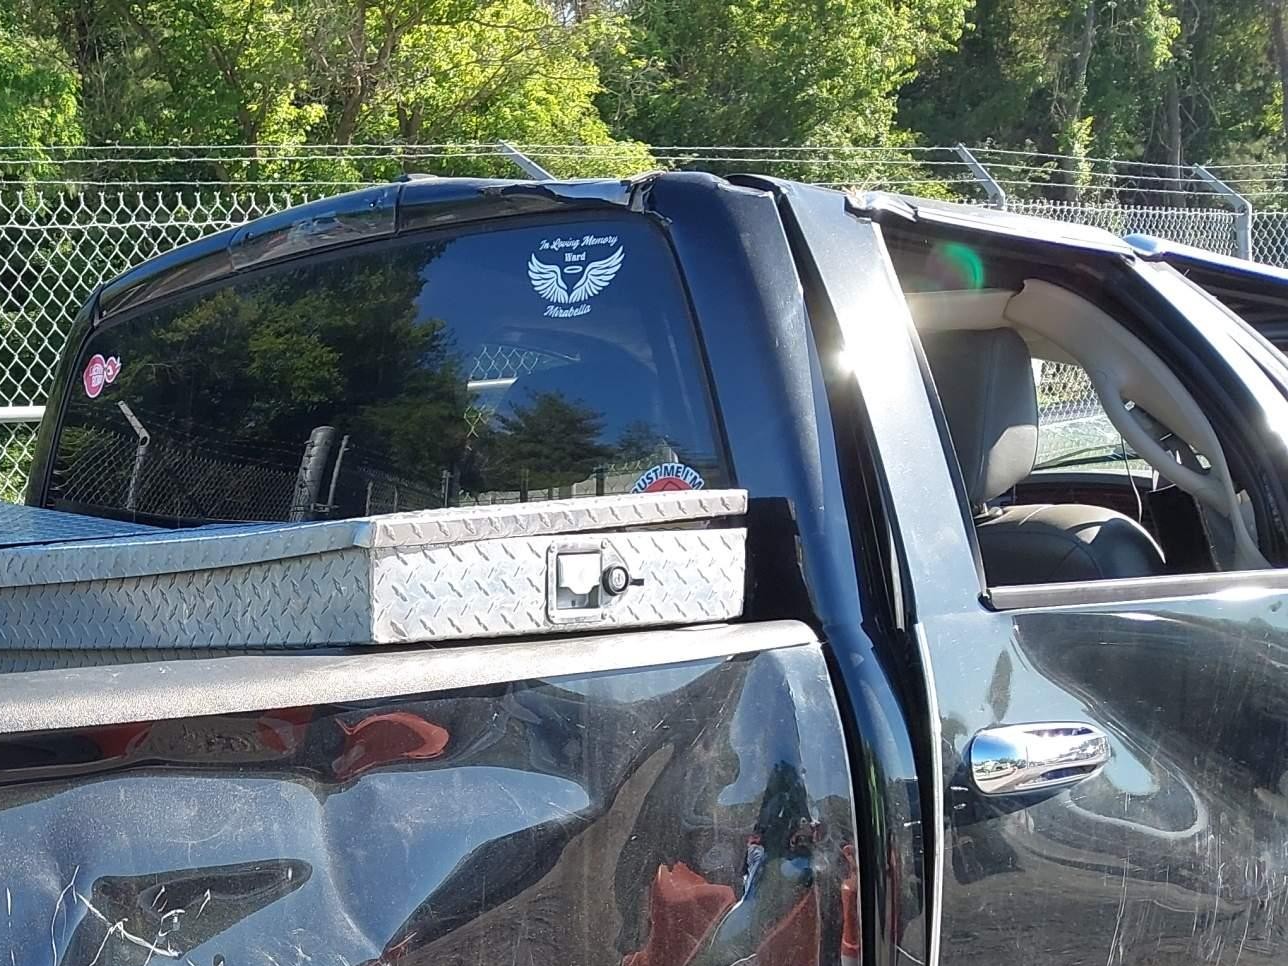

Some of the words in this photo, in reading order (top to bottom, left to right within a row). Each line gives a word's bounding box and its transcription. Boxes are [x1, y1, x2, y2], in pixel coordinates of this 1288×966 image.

[539, 240, 550, 250] In
[551, 238, 580, 251] Loving
[581, 235, 618, 247] Memory
[544, 304, 591, 318] Mirabella
[664, 465, 683, 478] ME
[683, 468, 703, 490] I'M
